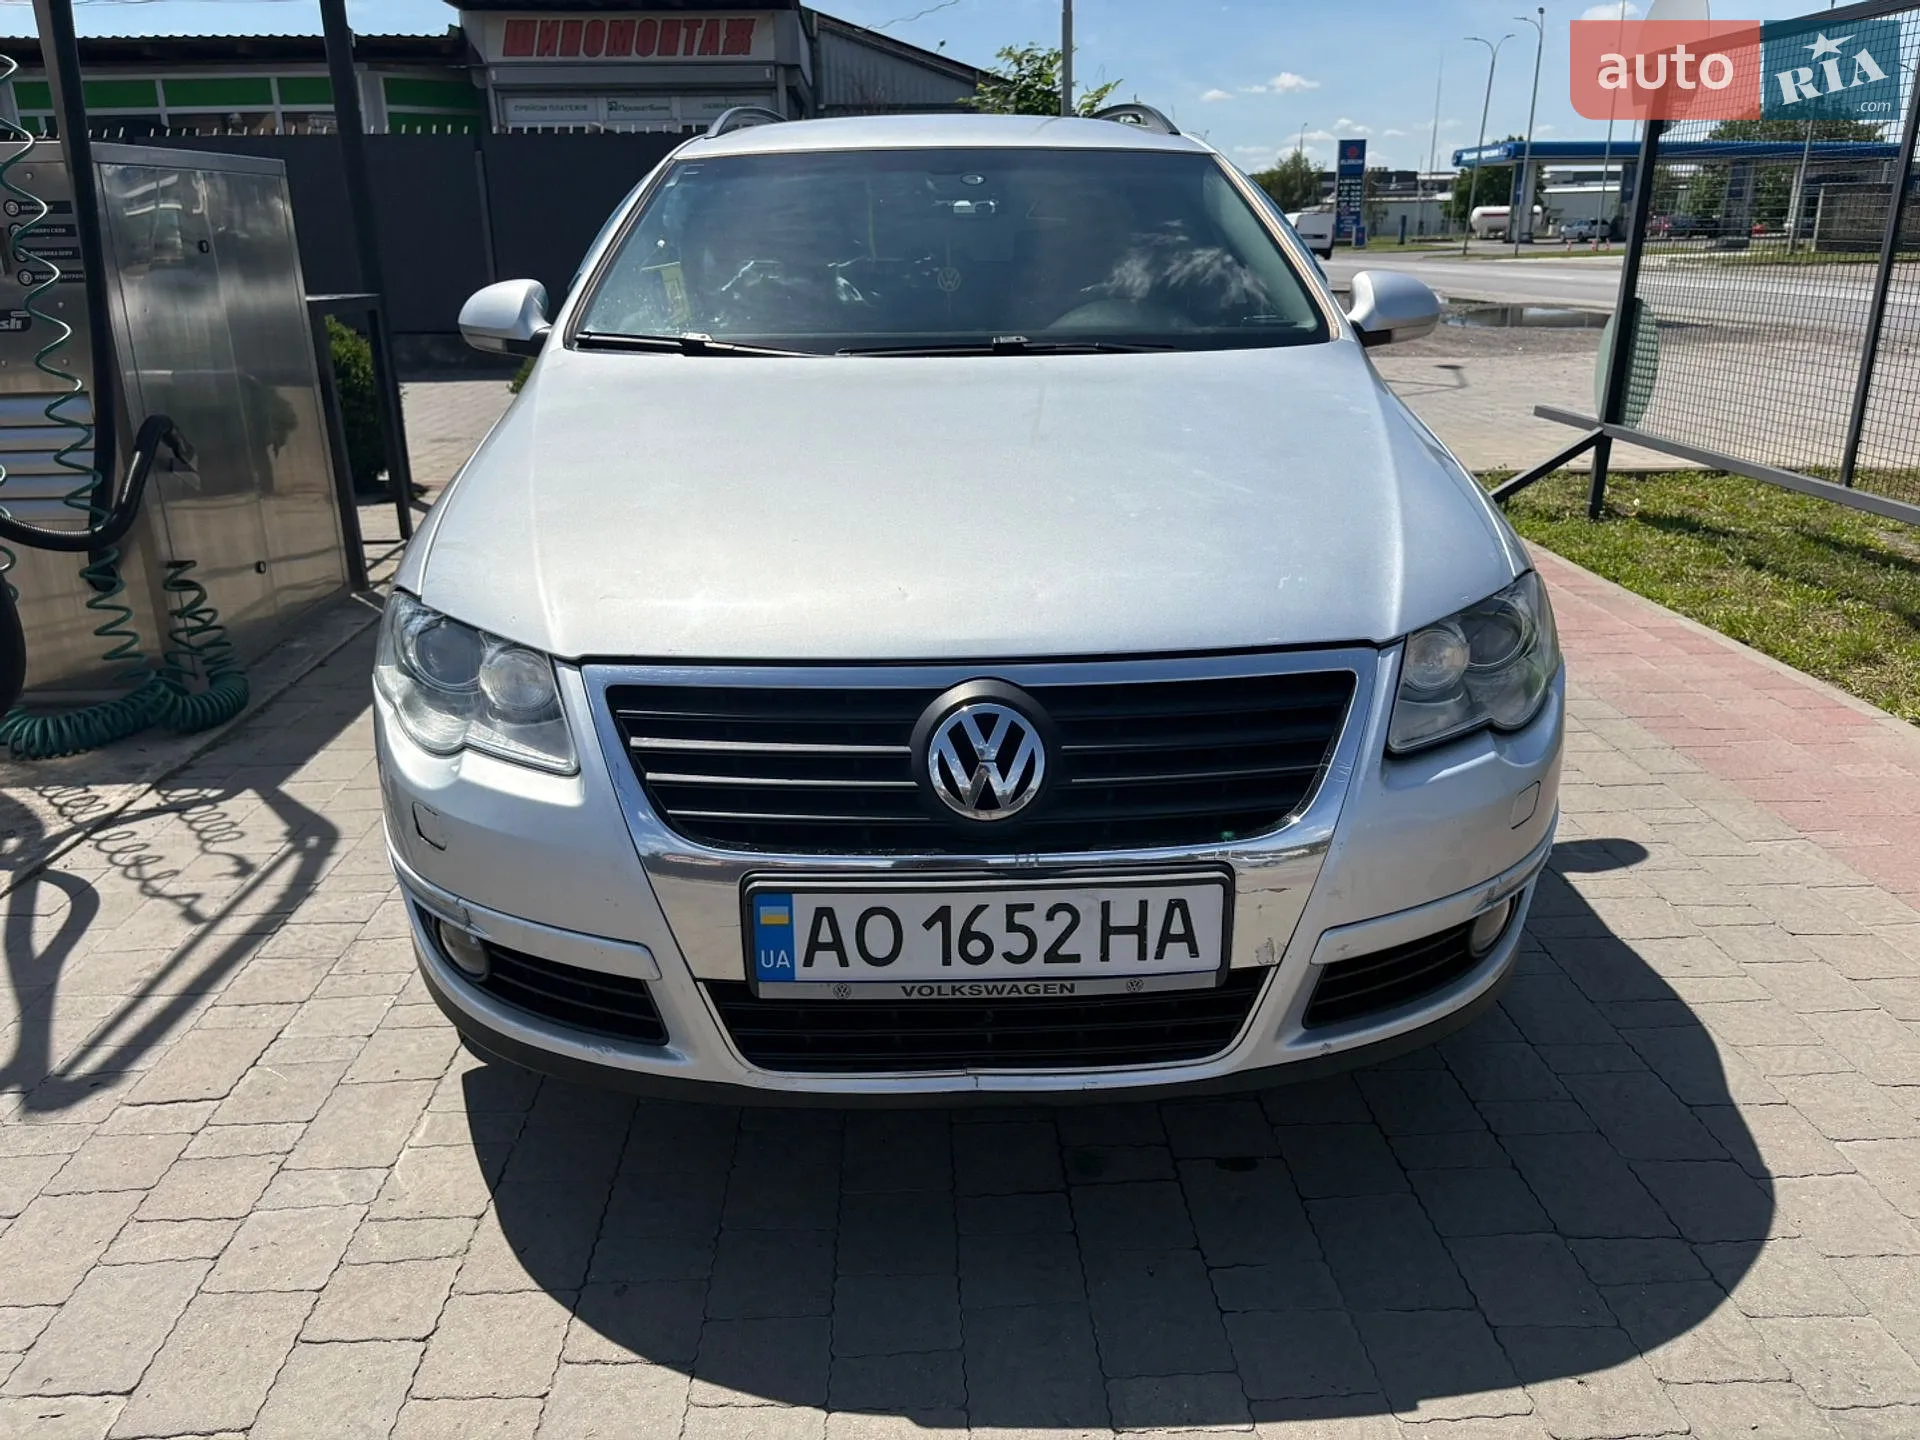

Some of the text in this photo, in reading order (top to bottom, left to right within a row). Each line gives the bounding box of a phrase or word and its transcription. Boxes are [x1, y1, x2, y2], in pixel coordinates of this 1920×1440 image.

[502, 18, 756, 57] ШИНОМОНТАЖ
[921, 902, 1082, 967] 1652
[760, 949, 791, 969] UA
[901, 982, 1076, 998] VOLKSWAGEN
